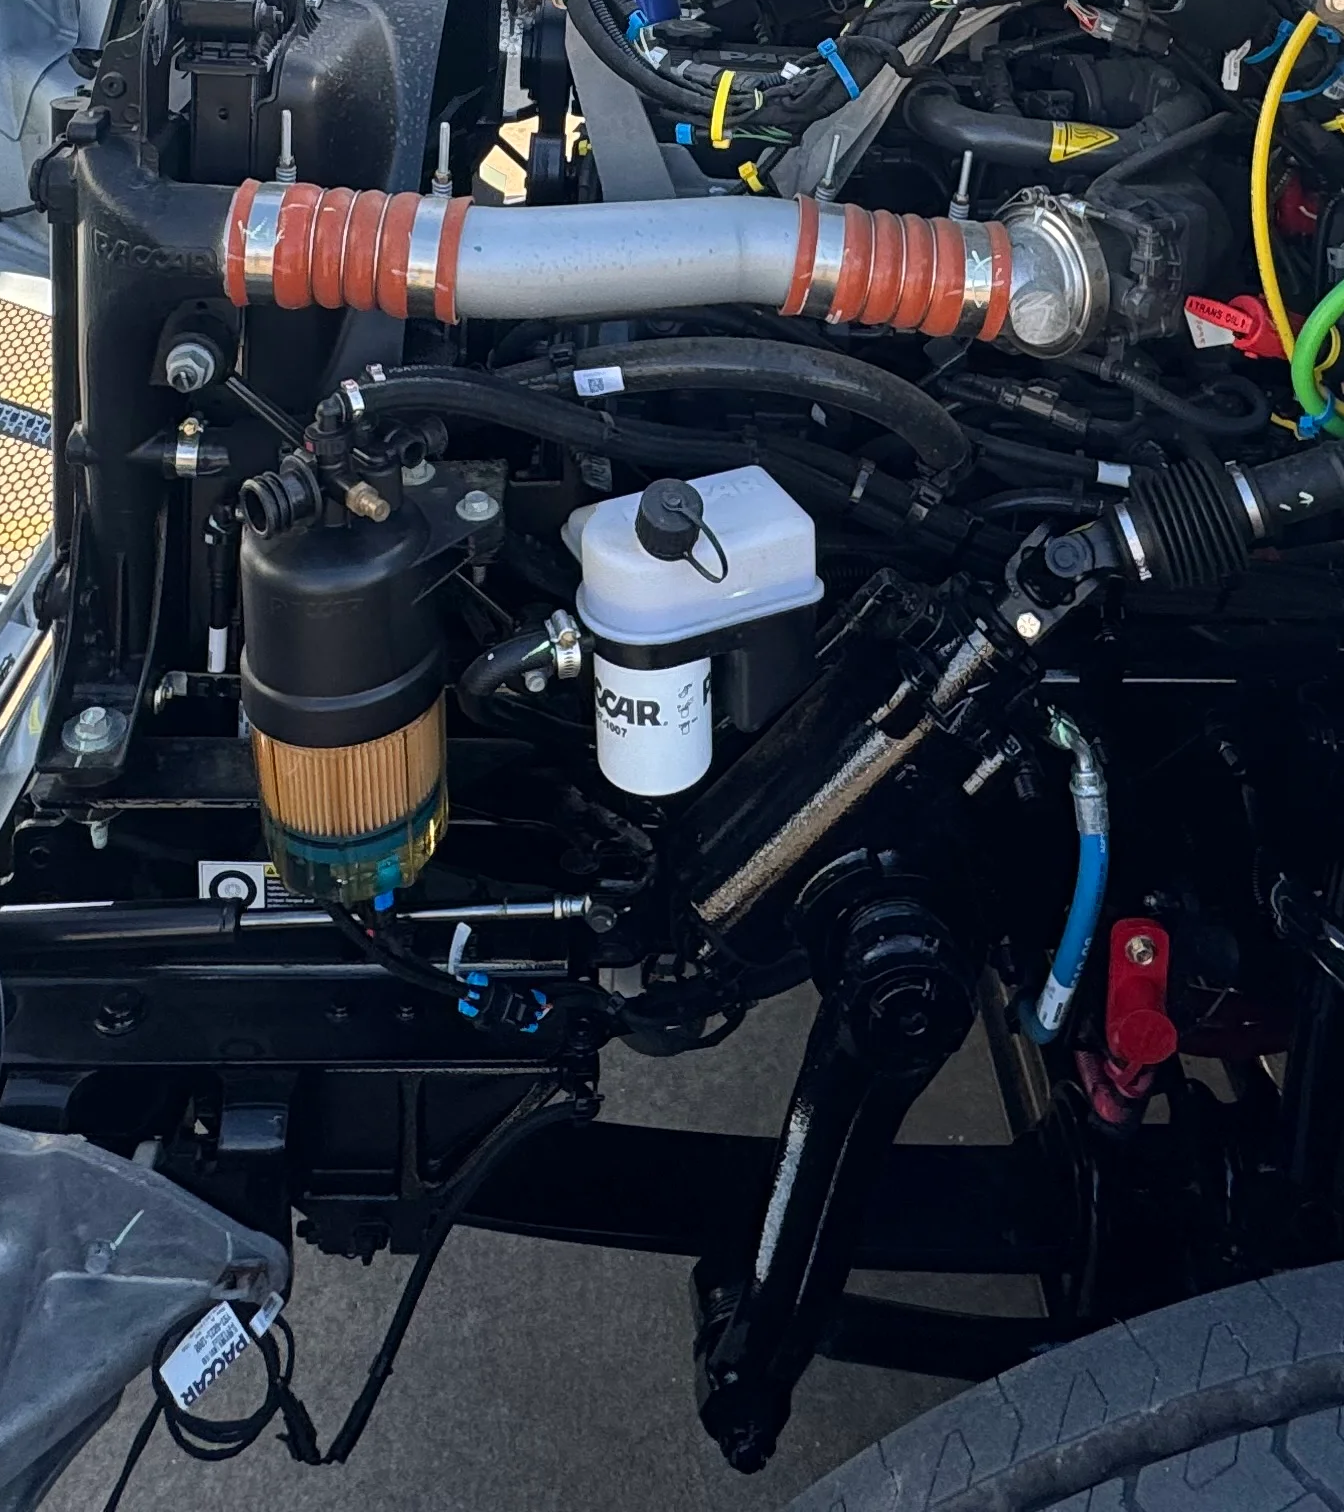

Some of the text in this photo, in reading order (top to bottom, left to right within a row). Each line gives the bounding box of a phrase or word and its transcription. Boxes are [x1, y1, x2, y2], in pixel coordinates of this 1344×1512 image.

[93, 228, 218, 278] PACCAR
[597, 710, 628, 738] -1007
[180, 1333, 249, 1406] PACCAR
